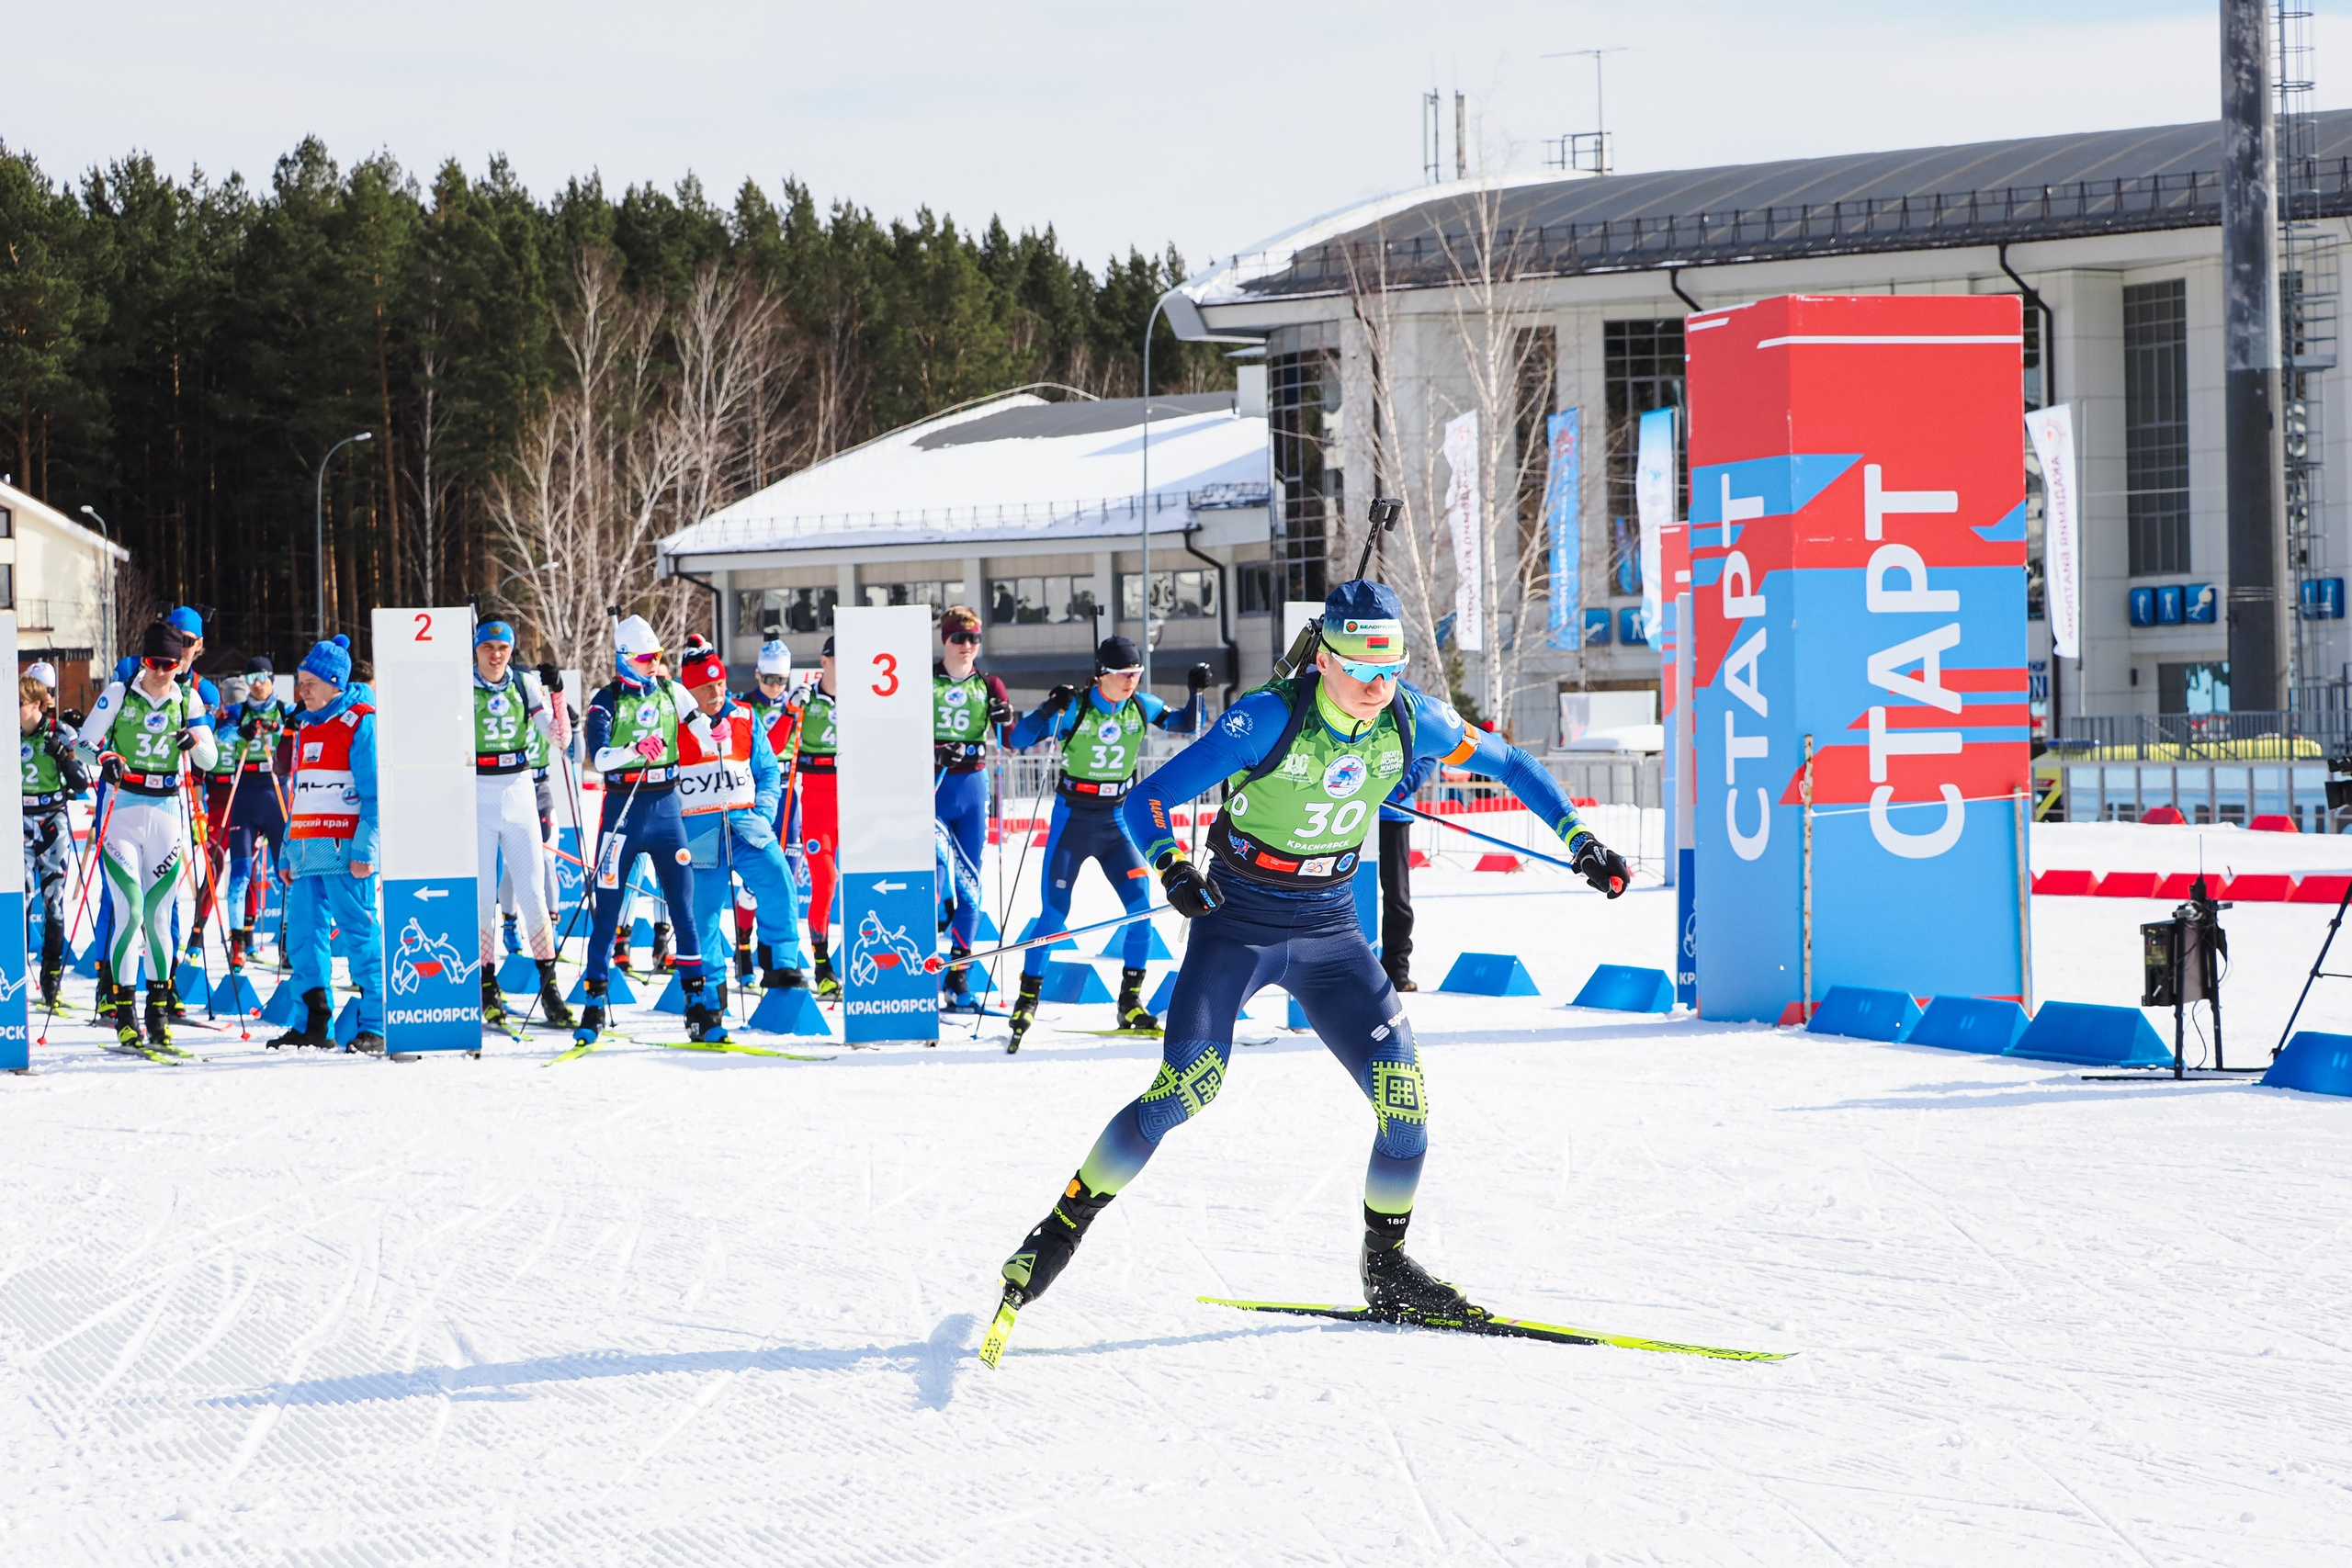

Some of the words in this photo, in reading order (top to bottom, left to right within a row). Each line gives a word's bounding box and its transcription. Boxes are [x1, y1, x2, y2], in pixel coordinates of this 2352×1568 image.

[414, 614, 433, 641] 2
[1721, 473, 1770, 862] СТАРТ
[1864, 464, 1965, 859] СТАРТ
[871, 653, 899, 697] 3
[482, 716, 516, 740] 35
[936, 706, 970, 731] 36
[135, 733, 170, 759] 34
[1090, 745, 1125, 770] 32
[322, 818, 349, 829] край
[1148, 798, 1167, 829] MAPLUS
[1294, 800, 1367, 838] 30
[1286, 839, 1350, 851] КРАСНОЯРСК
[388, 1006, 480, 1025] КРАСНОЯРСК
[847, 998, 937, 1016] КРАСНОЯРСК
[1386, 1217, 1407, 1225] 180
[1424, 1317, 1464, 1327] FISCHER
[1641, 1340, 1751, 1357] FISCHER
